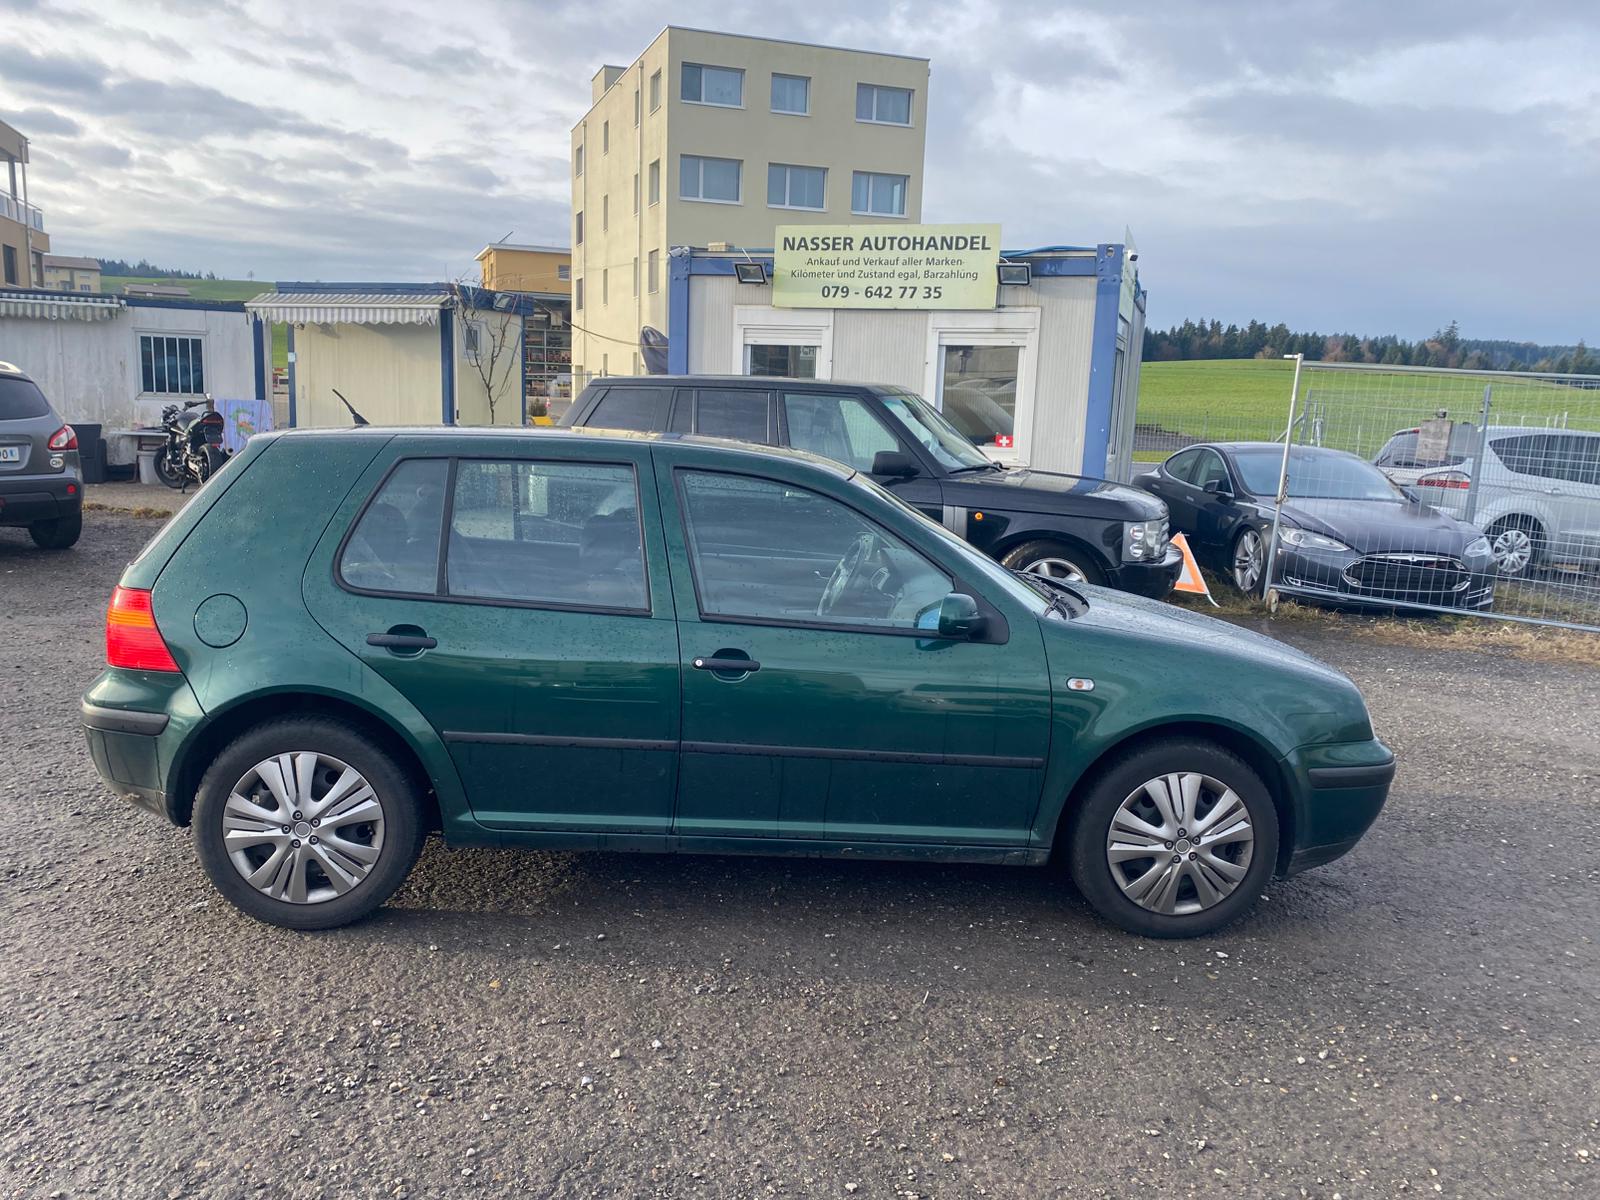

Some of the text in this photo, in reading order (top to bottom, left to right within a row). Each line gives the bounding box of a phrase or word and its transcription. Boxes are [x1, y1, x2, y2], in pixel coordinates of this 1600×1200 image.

[783, 236, 991, 251] NASSER AUTOHANDEL
[806, 257, 963, 266] Ankauf und Verkauf aller Marken
[791, 270, 979, 281] Kilometer und Zustand egal, Barzahlung
[821, 285, 850, 299] 079
[864, 285, 893, 299] 642
[899, 286, 918, 299] 77
[922, 286, 943, 299] 35
